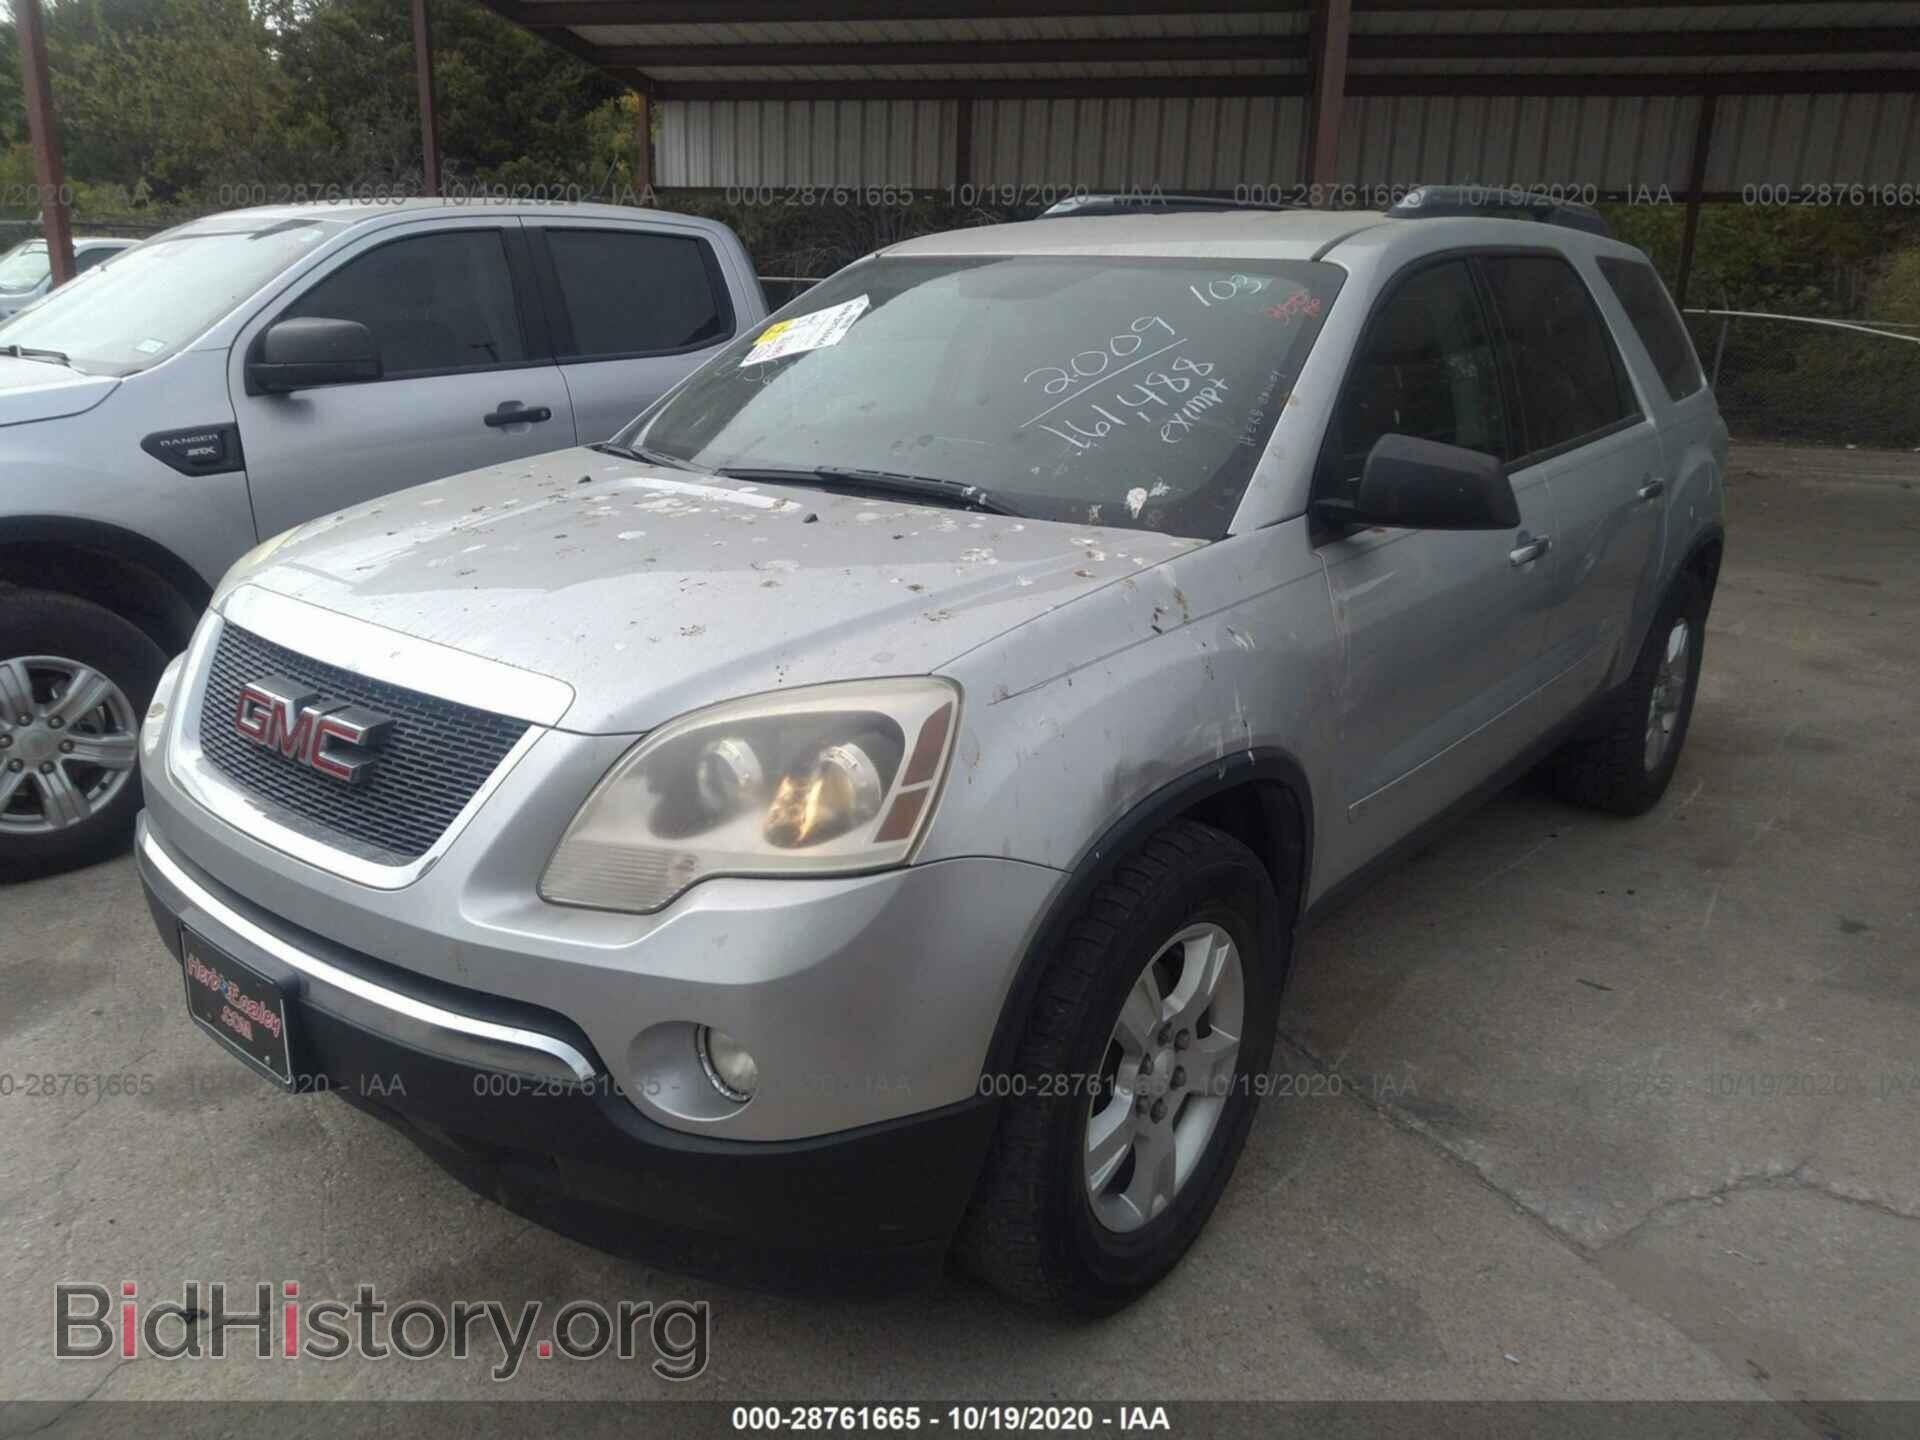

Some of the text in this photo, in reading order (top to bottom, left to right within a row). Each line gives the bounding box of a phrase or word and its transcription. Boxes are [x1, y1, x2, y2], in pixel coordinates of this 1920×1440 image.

[1190, 273, 1263, 307] 103
[1024, 316, 1175, 394] 2009
[233, 682, 368, 783] GMC
